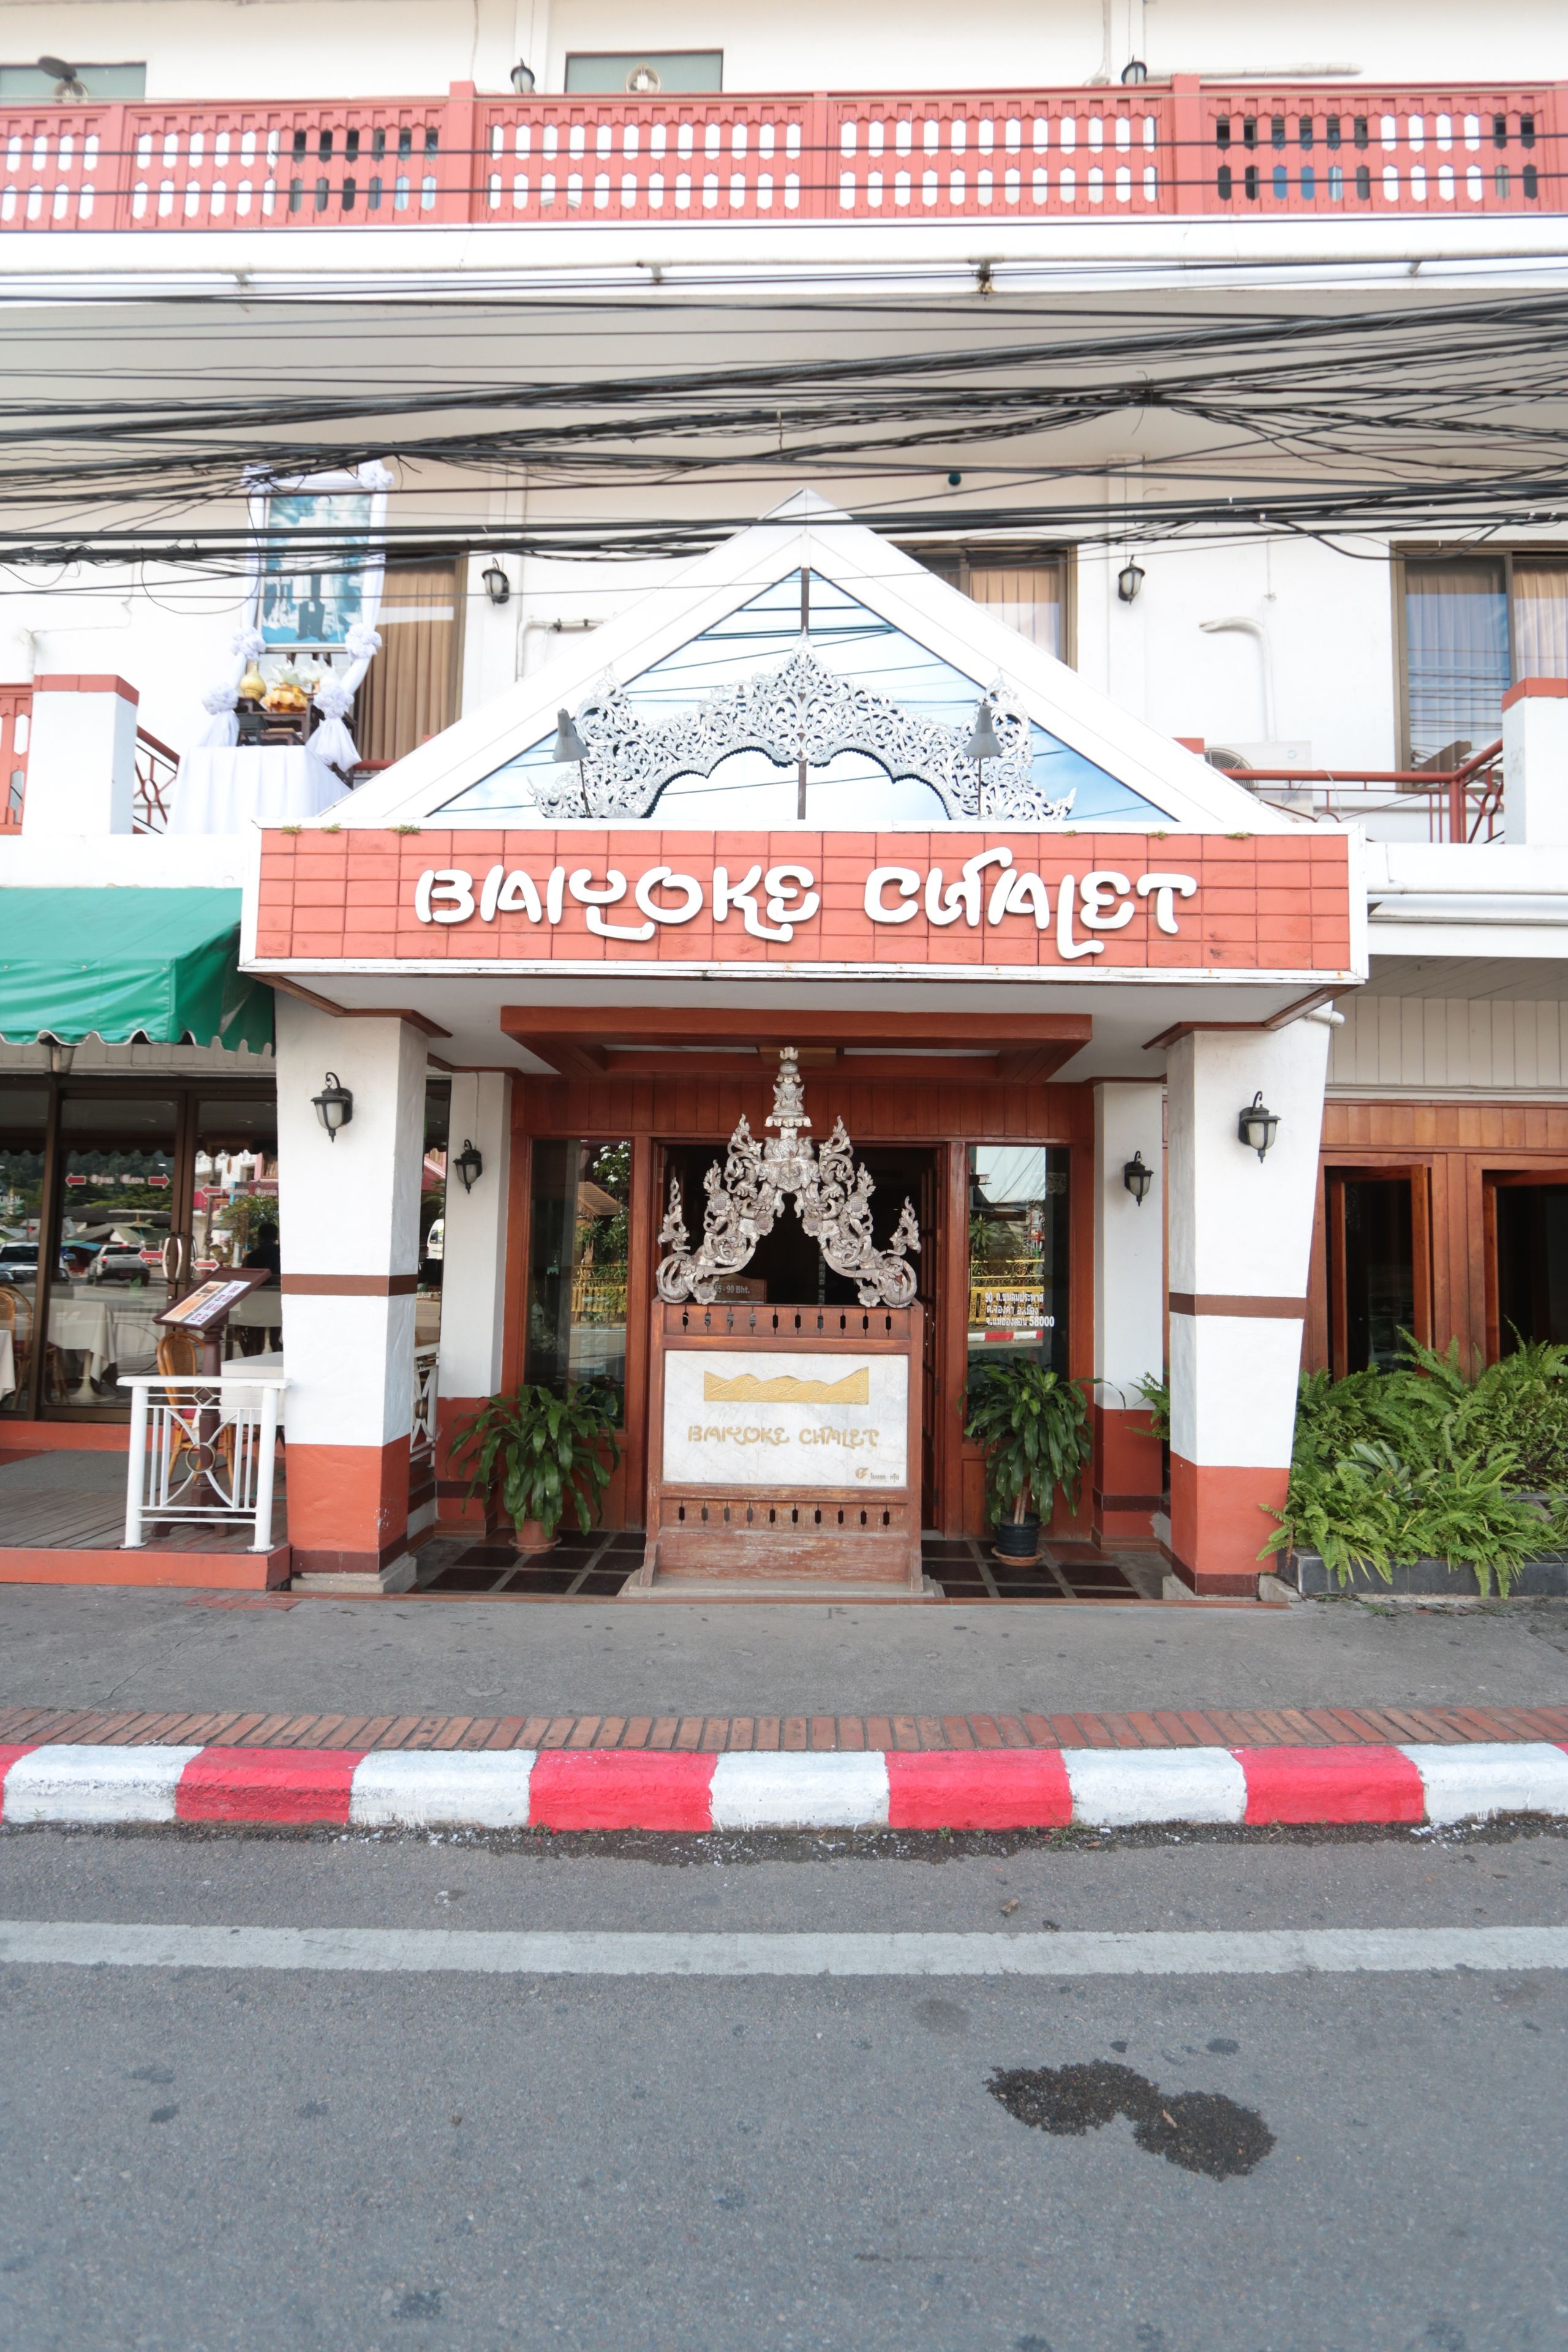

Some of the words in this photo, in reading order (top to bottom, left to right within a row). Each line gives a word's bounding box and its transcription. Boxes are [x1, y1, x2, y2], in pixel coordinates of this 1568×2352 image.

[415, 864, 820, 943] BAIYOKE
[864, 846, 1197, 959] CHALET
[89, 1174, 115, 1186] Open
[119, 1174, 145, 1185] Close
[254, 1187, 278, 1197] Open
[726, 1285, 734, 1294] 90
[736, 1285, 750, 1294] Bht.
[985, 1292, 993, 1303] 90
[1029, 1316, 1055, 1327] 58000
[687, 1425, 790, 1446] BAIYOKE
[799, 1426, 880, 1450] CHALET
